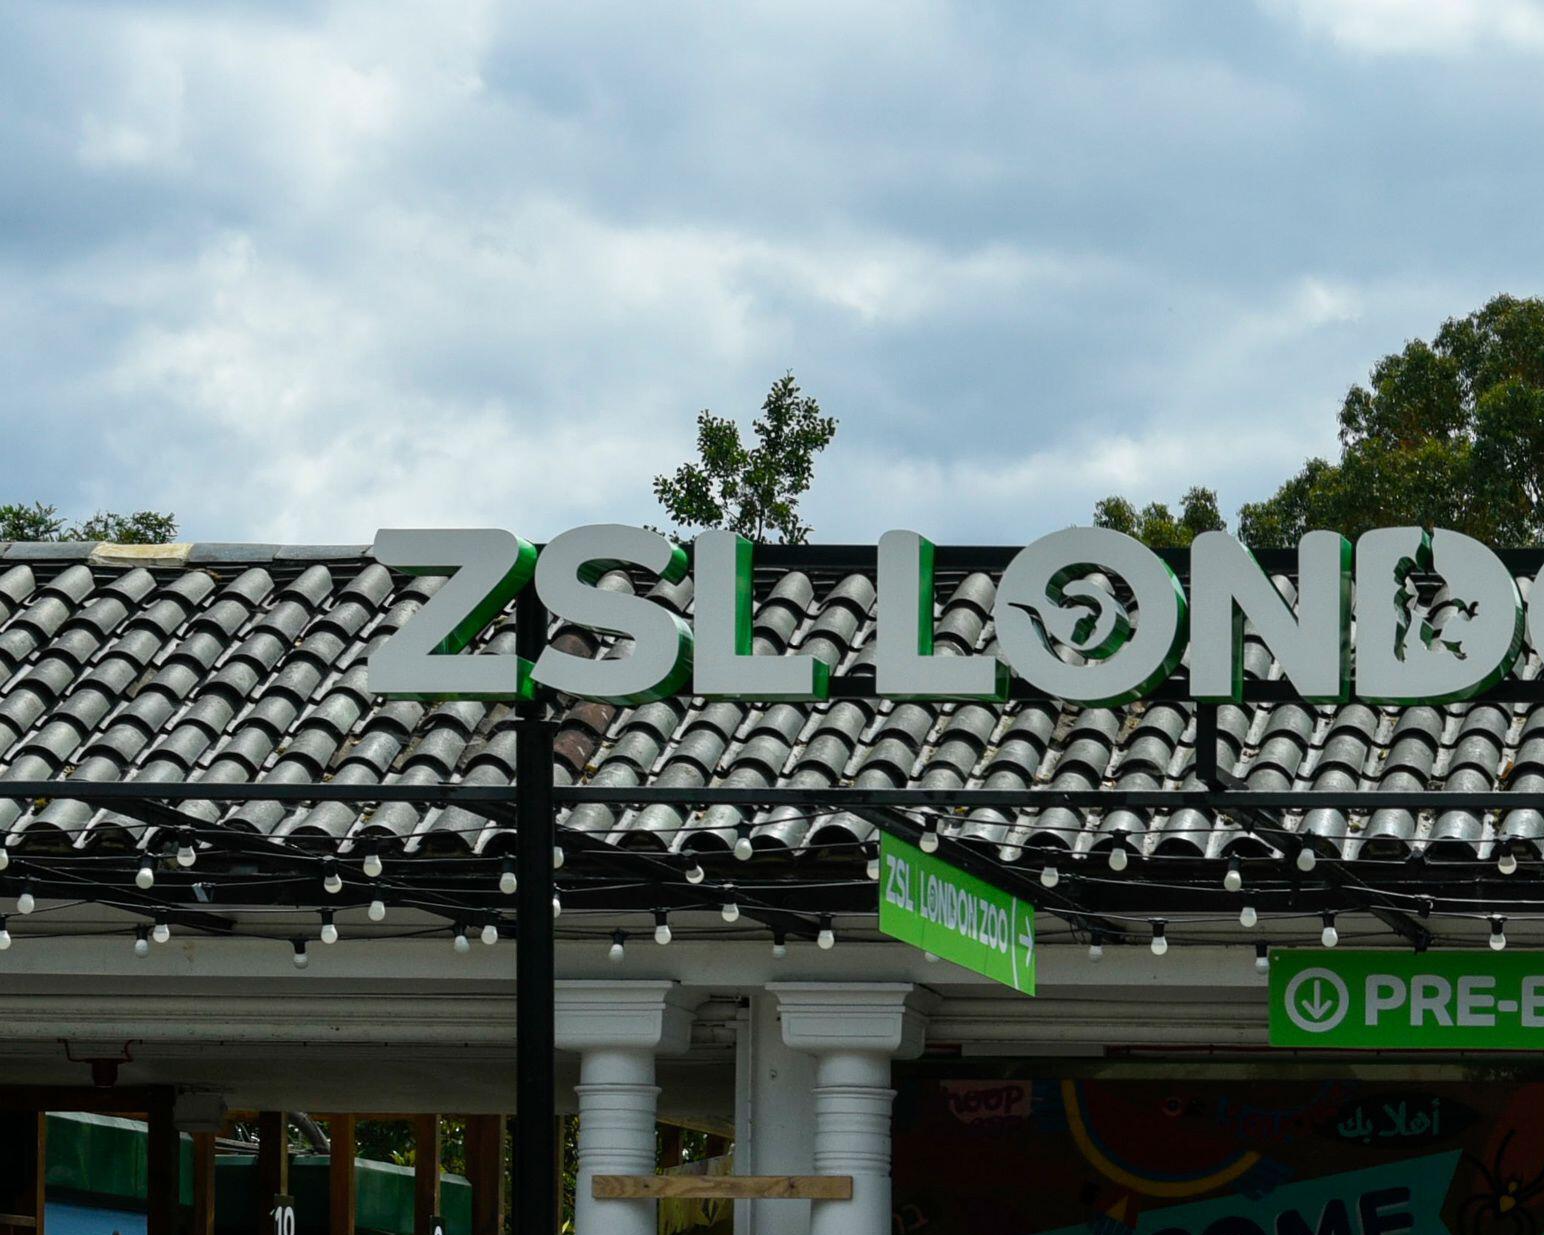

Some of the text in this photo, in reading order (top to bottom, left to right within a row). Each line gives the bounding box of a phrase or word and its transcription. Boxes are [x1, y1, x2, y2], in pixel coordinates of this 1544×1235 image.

[369, 524, 826, 702] ZSL
[886, 853, 1008, 954] ZSL LONDON ZOO
